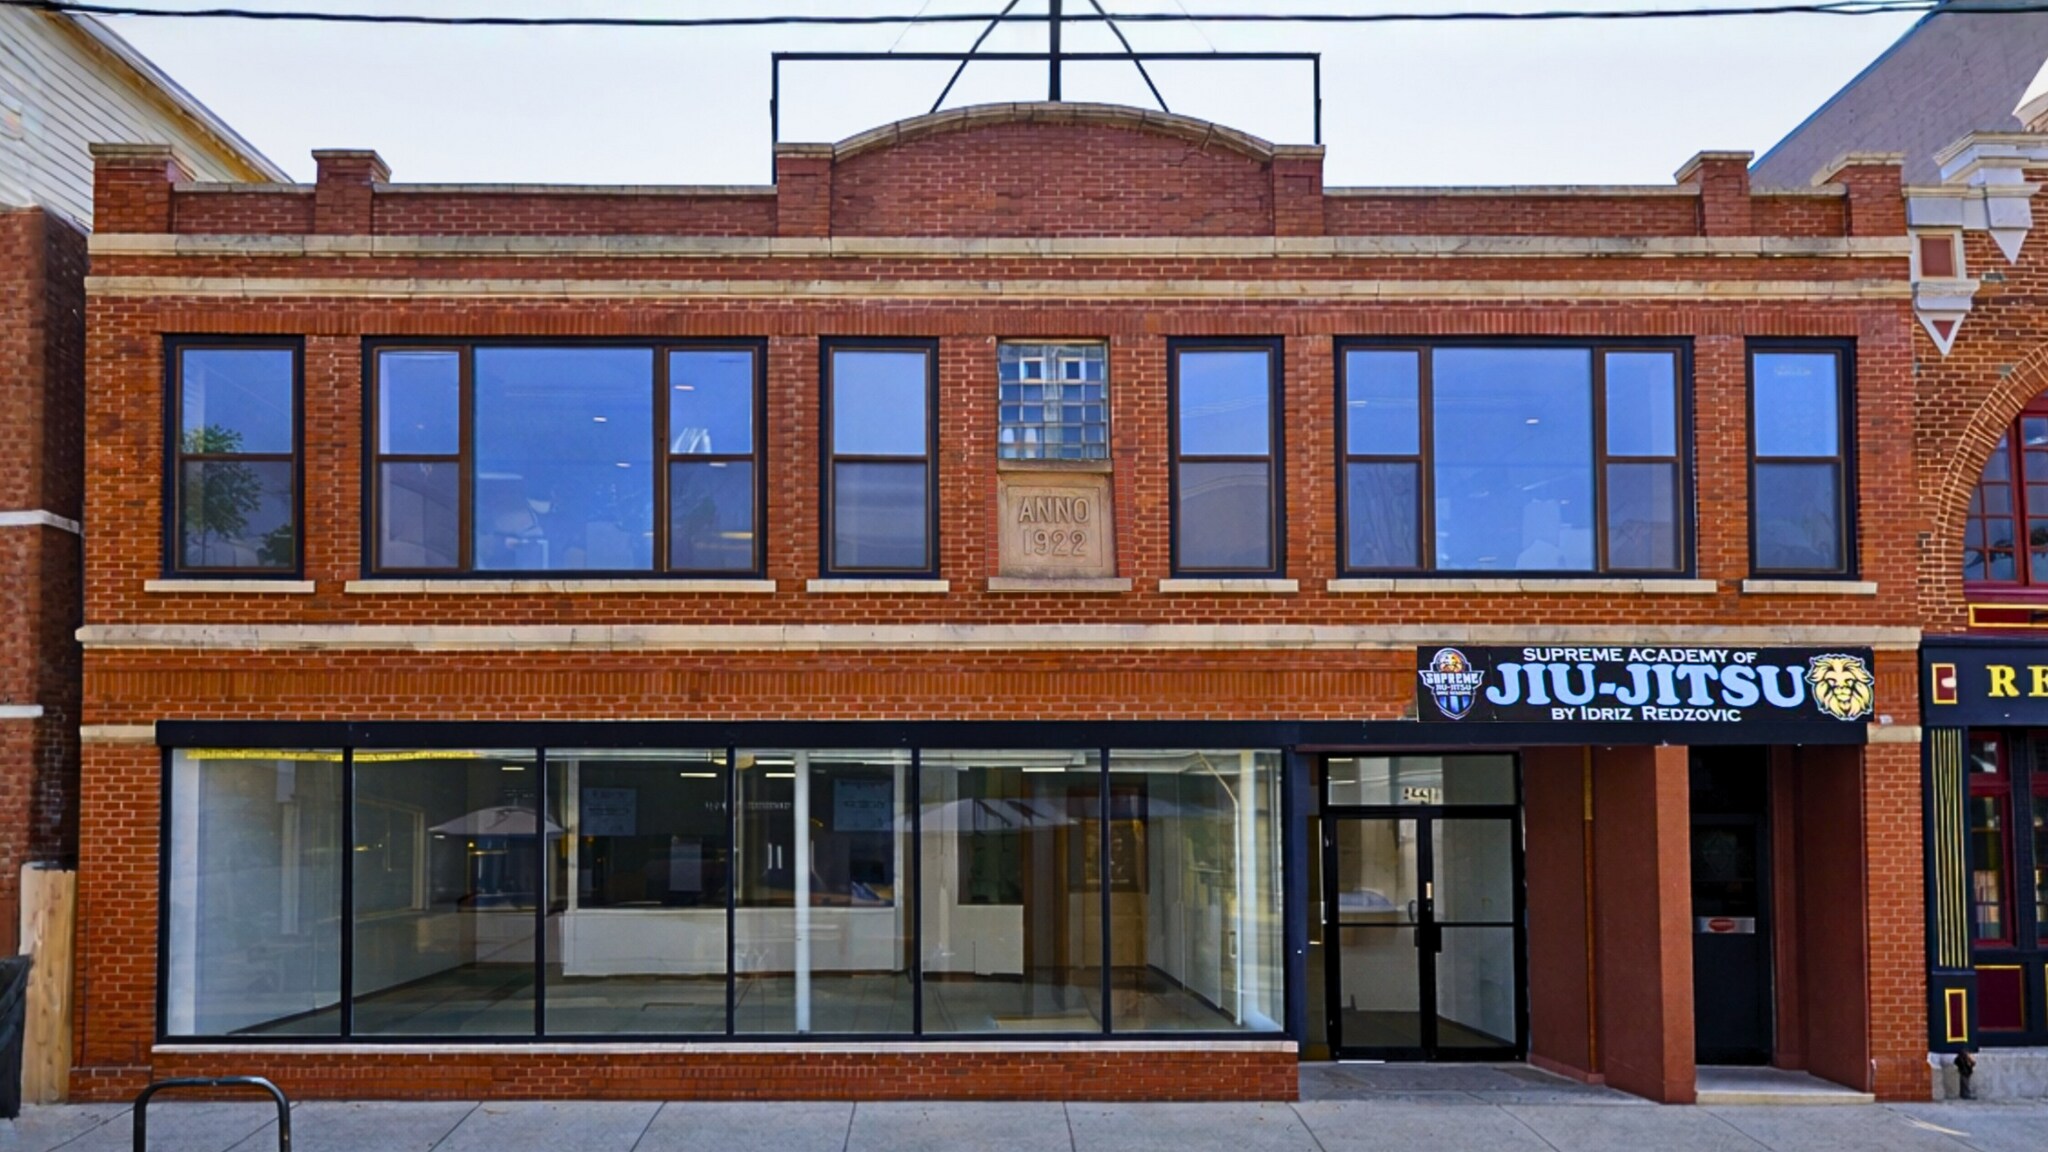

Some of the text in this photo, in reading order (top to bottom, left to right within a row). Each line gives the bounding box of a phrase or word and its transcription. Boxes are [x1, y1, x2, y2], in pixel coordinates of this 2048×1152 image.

[1018, 496, 1089, 524] ANNO
[1024, 529, 1087, 556] 1922
[1523, 647, 1757, 663] SUPREME ACADEMY OF
[1426, 672, 1479, 684] SUPREME
[1485, 662, 1806, 707] JIU-JITSU
[1551, 706, 1742, 722] BY IDRIZ REDZOVIC
